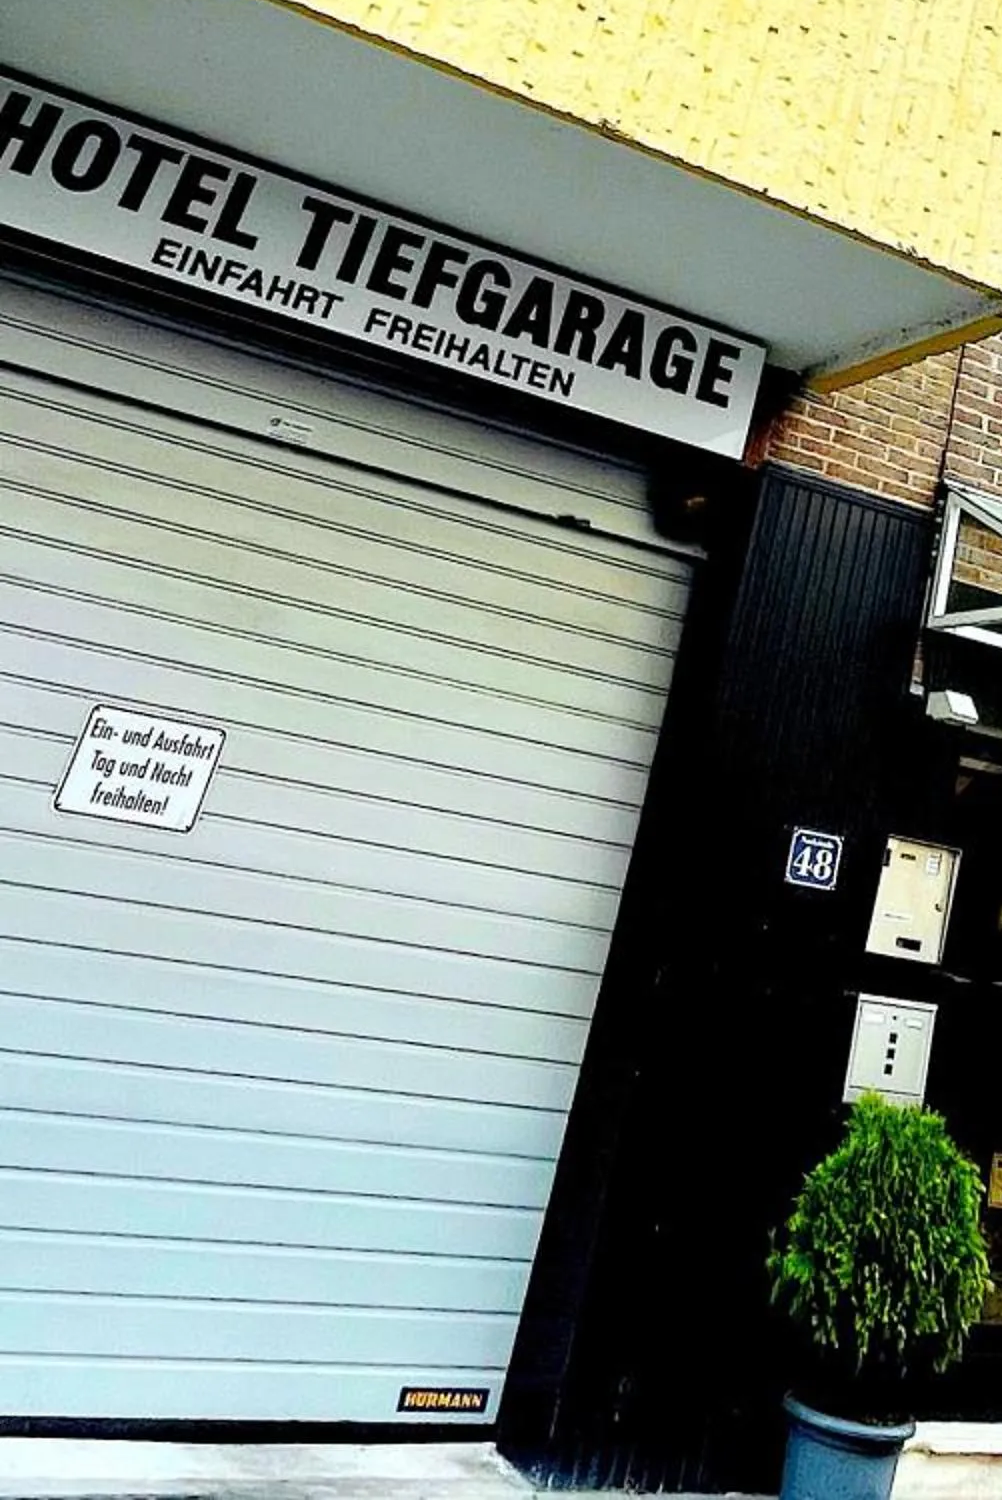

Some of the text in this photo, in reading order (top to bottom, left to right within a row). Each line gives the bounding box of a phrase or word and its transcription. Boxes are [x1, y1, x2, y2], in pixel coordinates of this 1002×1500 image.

[0, 90, 742, 408] HOTEL TIEFGARAGE
[151, 237, 574, 399] EINFAHRT FREIHALTEN
[91, 717, 214, 760] Ein- und Ausfahrt
[91, 750, 193, 787] Tag und Nacht
[90, 781, 169, 815] freihalten!
[793, 846, 833, 880] 48
